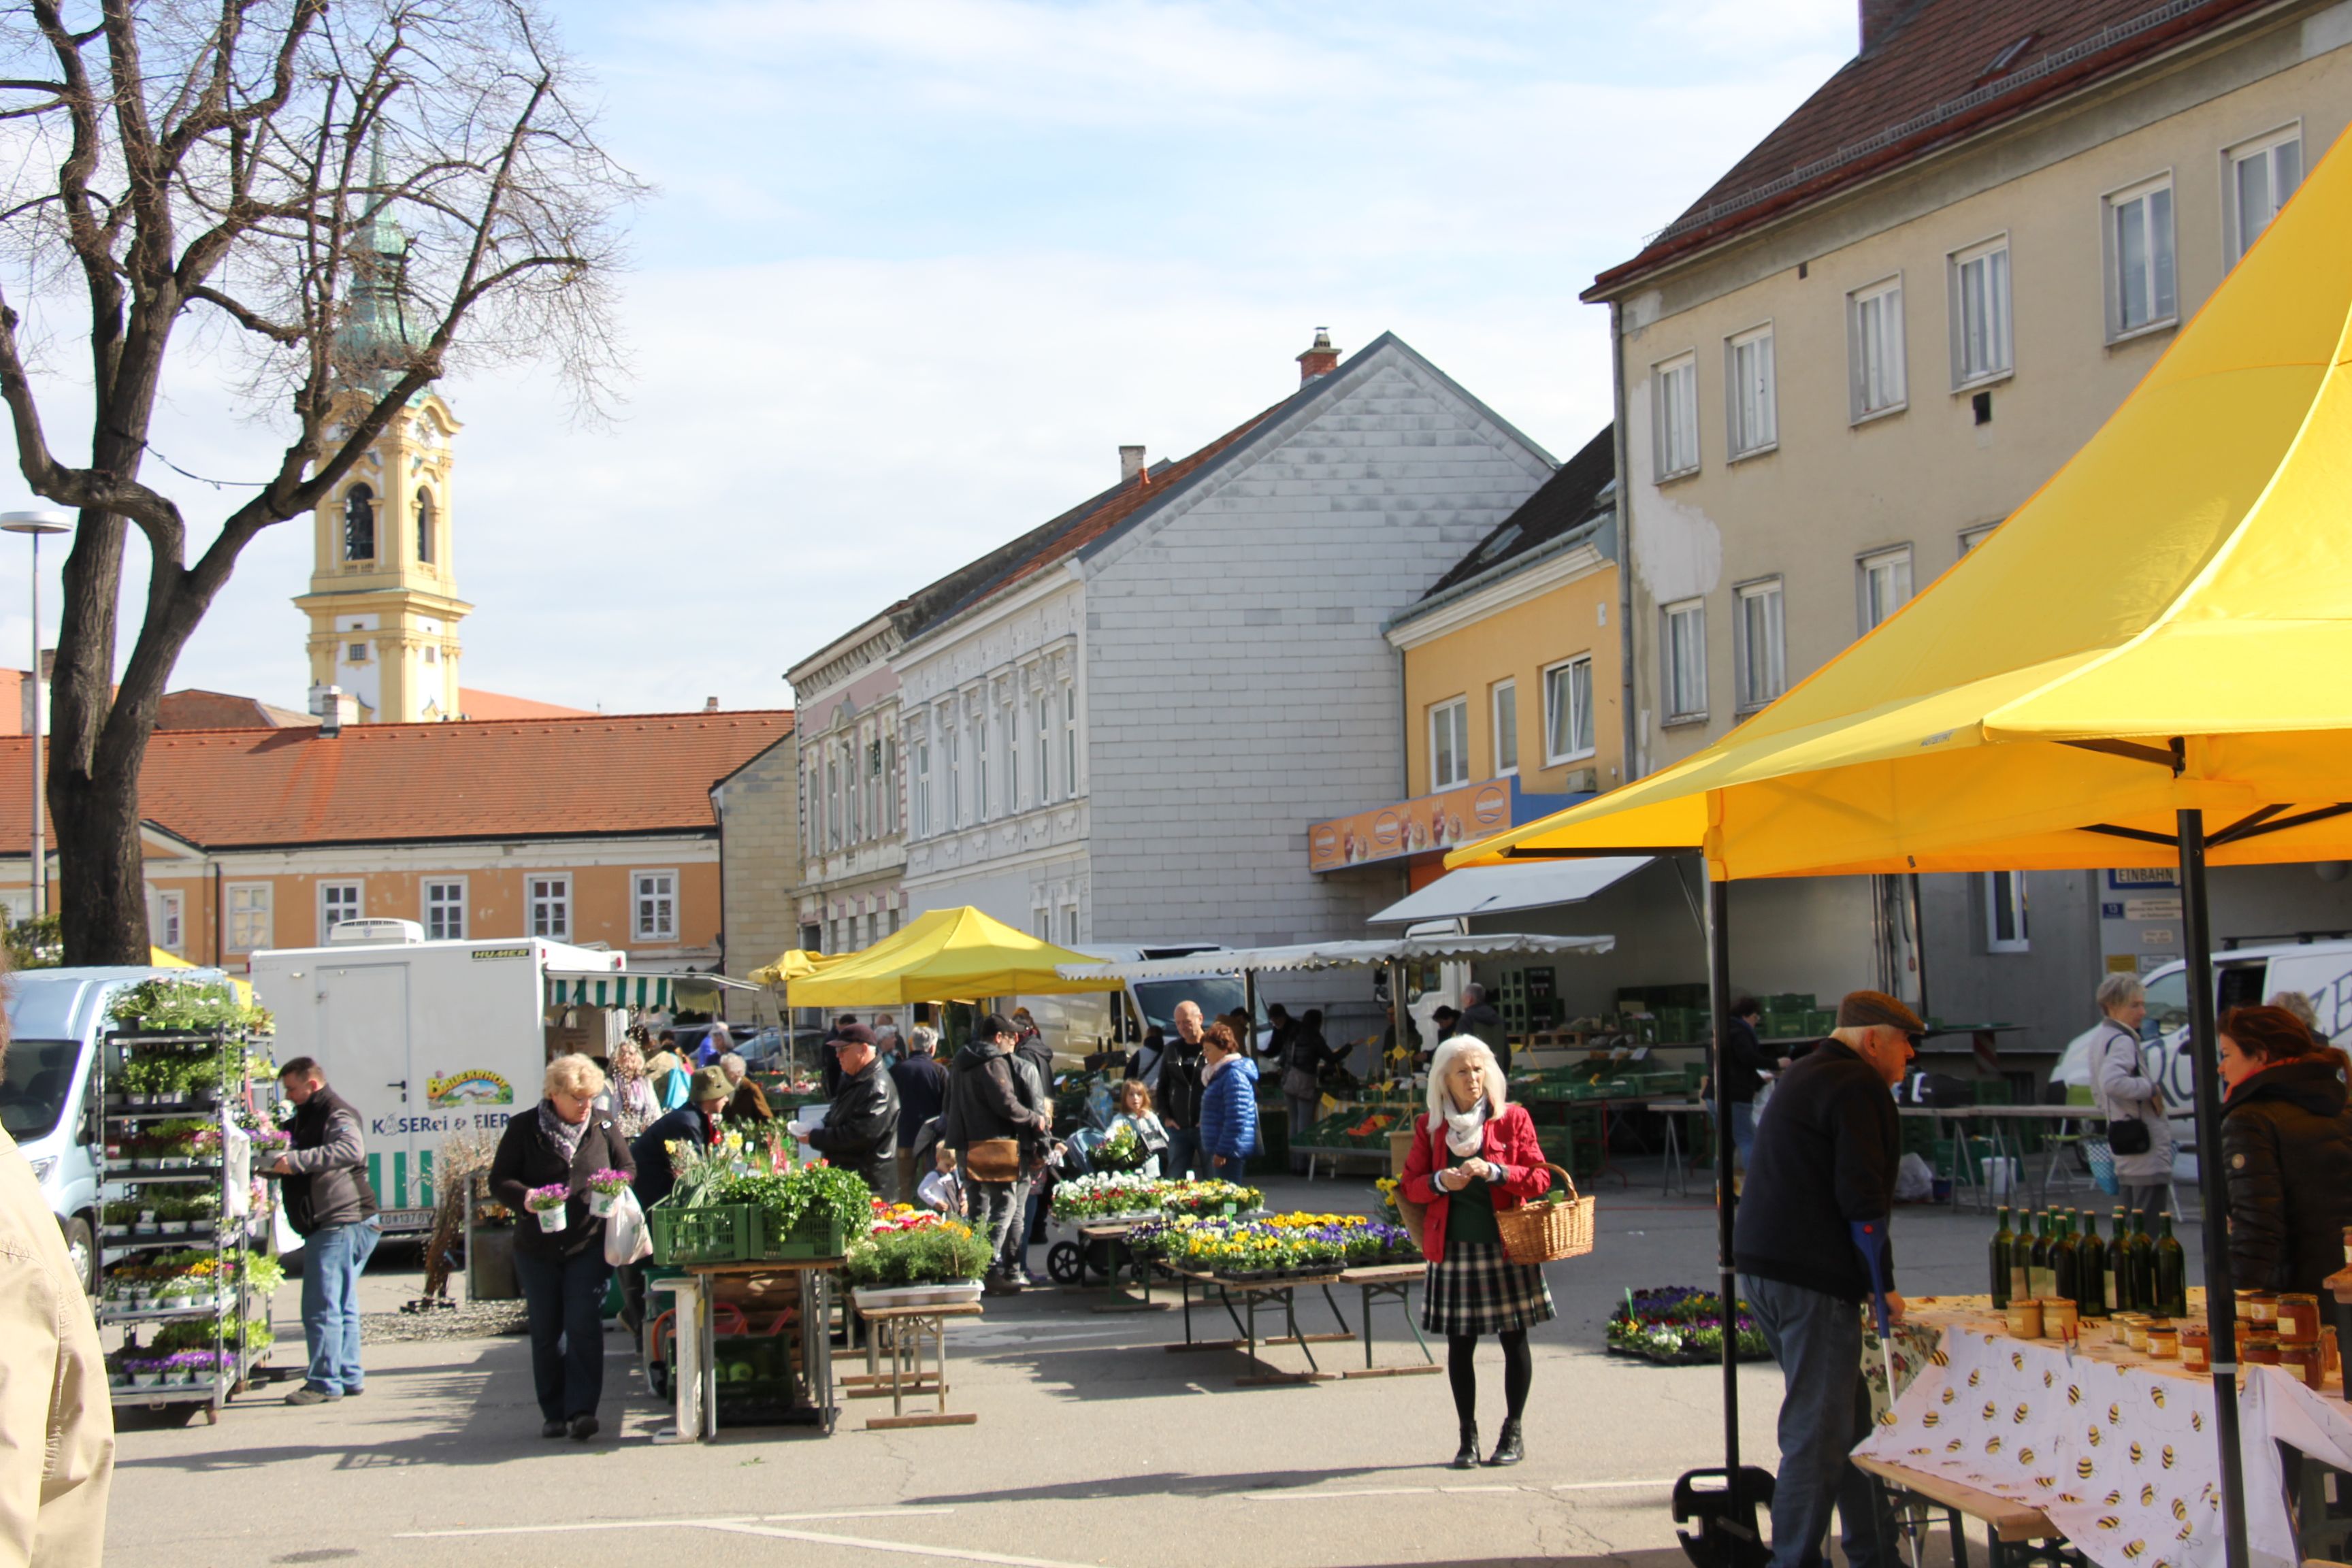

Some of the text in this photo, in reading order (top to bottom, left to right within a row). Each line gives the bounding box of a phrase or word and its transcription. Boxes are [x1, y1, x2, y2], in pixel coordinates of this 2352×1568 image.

[2119, 868, 2173, 882] EINBAHN
[474, 949, 527, 958] HUMER
[474, 1113, 510, 1129] EIER
